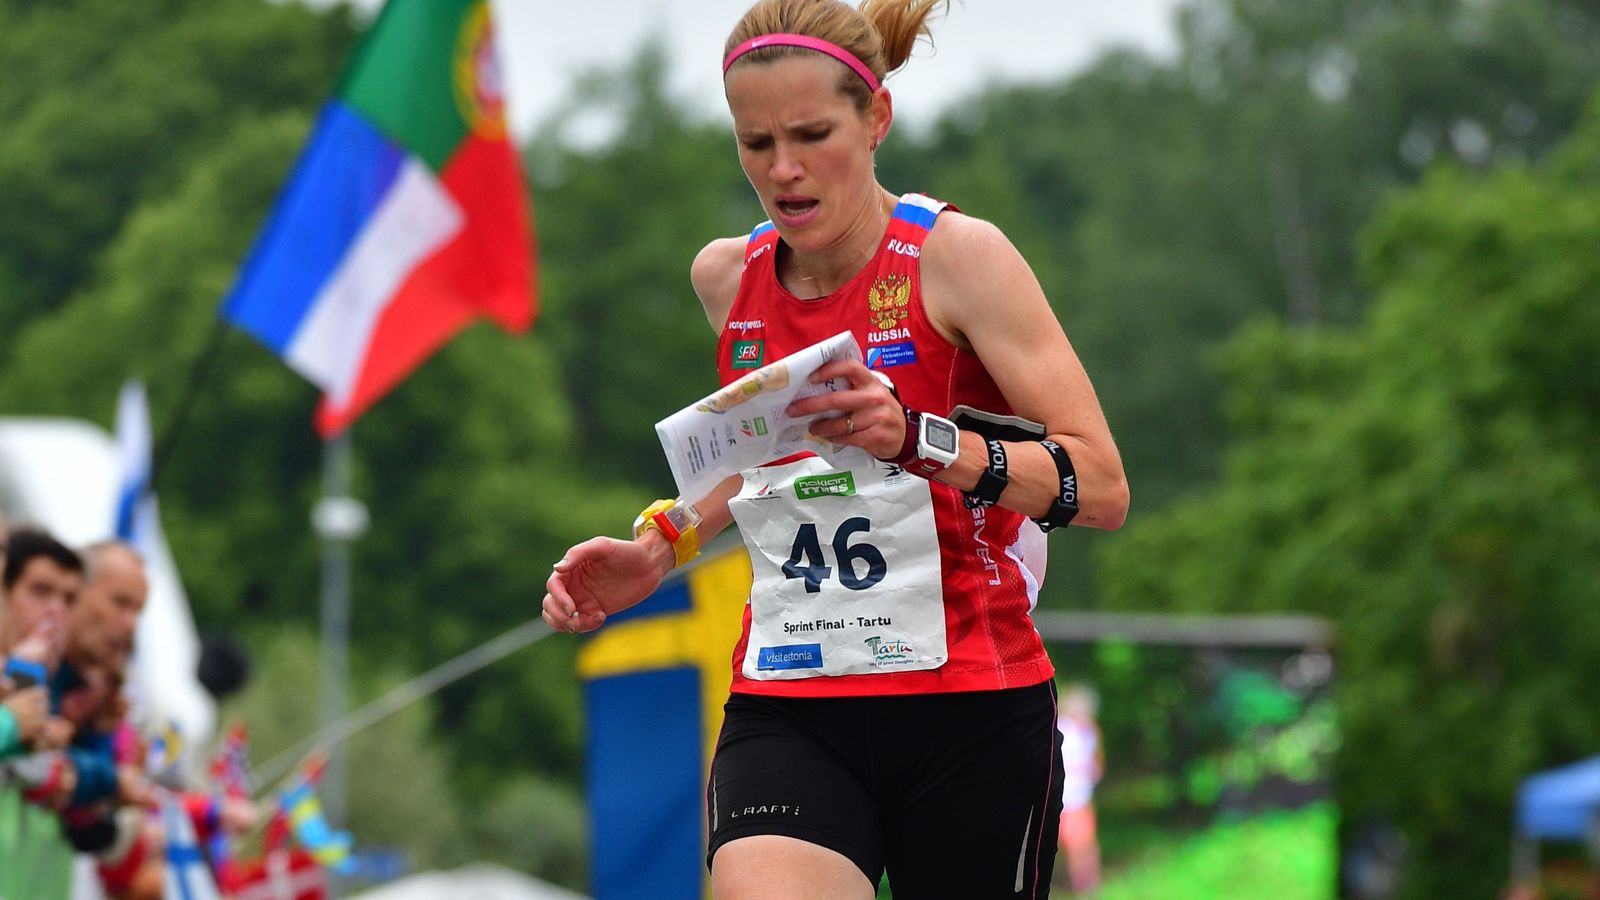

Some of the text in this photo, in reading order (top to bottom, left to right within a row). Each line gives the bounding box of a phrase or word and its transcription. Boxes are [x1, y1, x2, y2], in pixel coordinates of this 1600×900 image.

[867, 327, 911, 343] RUSSIA
[738, 345, 757, 359] SFR
[801, 484, 849, 495] TYRES
[781, 516, 888, 593] 46
[784, 621, 814, 635] Sprint
[816, 619, 845, 631] Final
[857, 616, 892, 628] Tartu
[864, 635, 913, 656] Tartu
